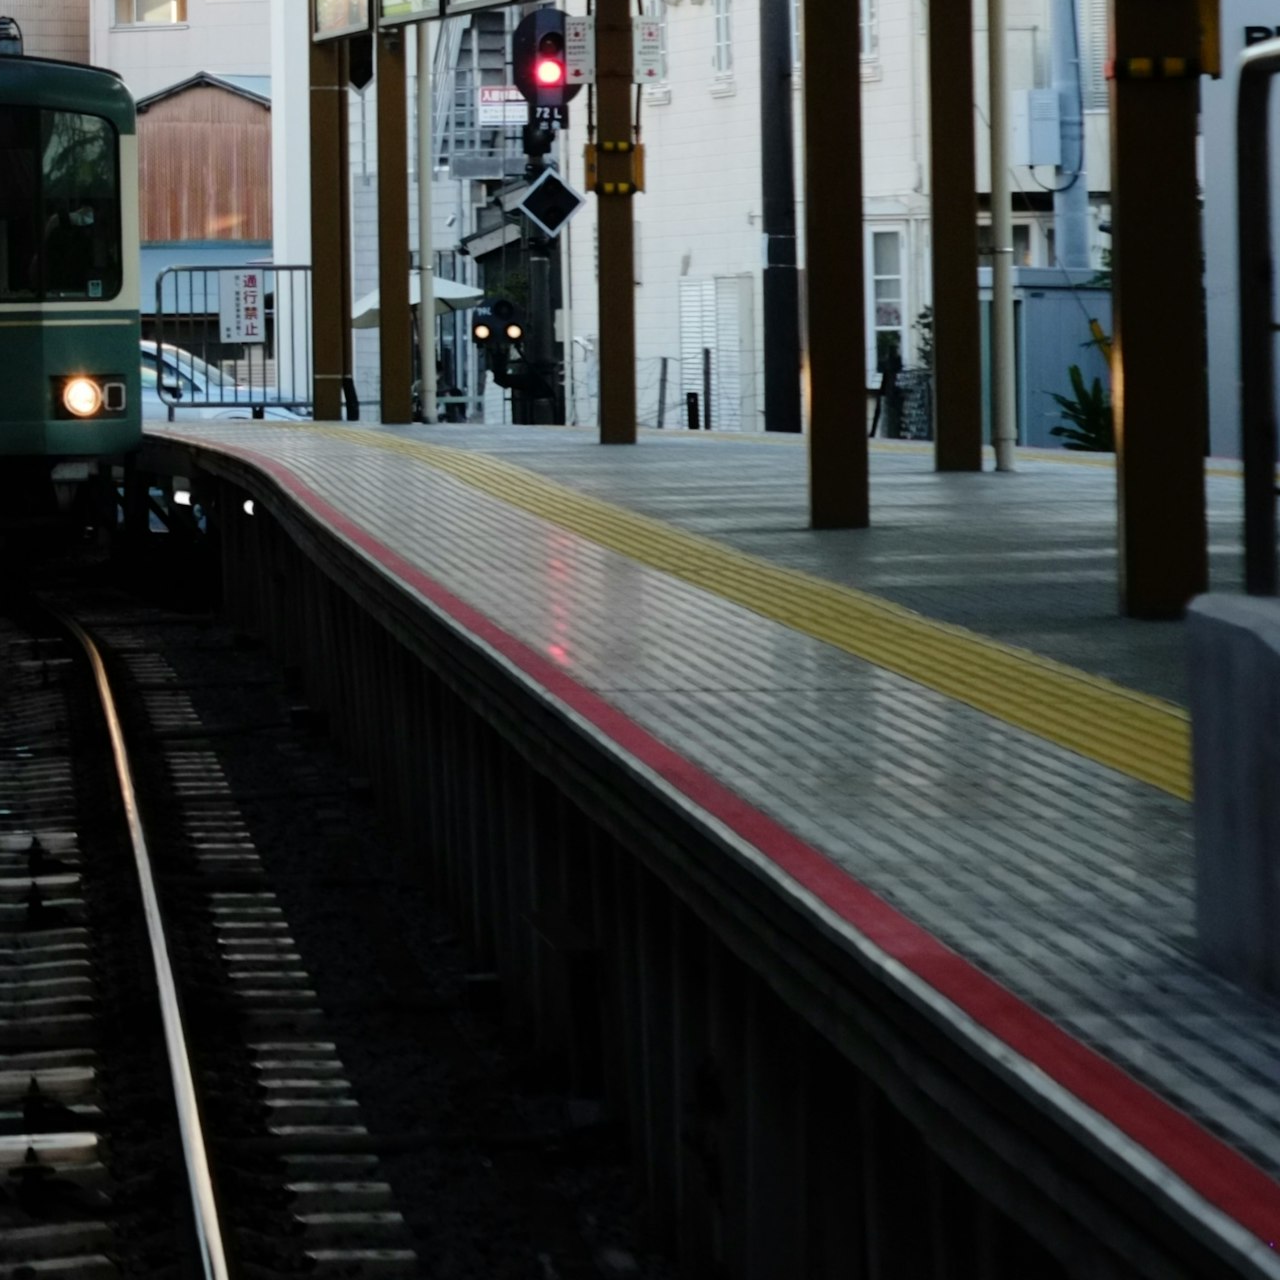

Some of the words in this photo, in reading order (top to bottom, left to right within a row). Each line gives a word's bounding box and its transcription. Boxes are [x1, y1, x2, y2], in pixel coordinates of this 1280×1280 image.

[553, 106, 562, 119] L
[243, 273, 259, 337] 通行禁止
